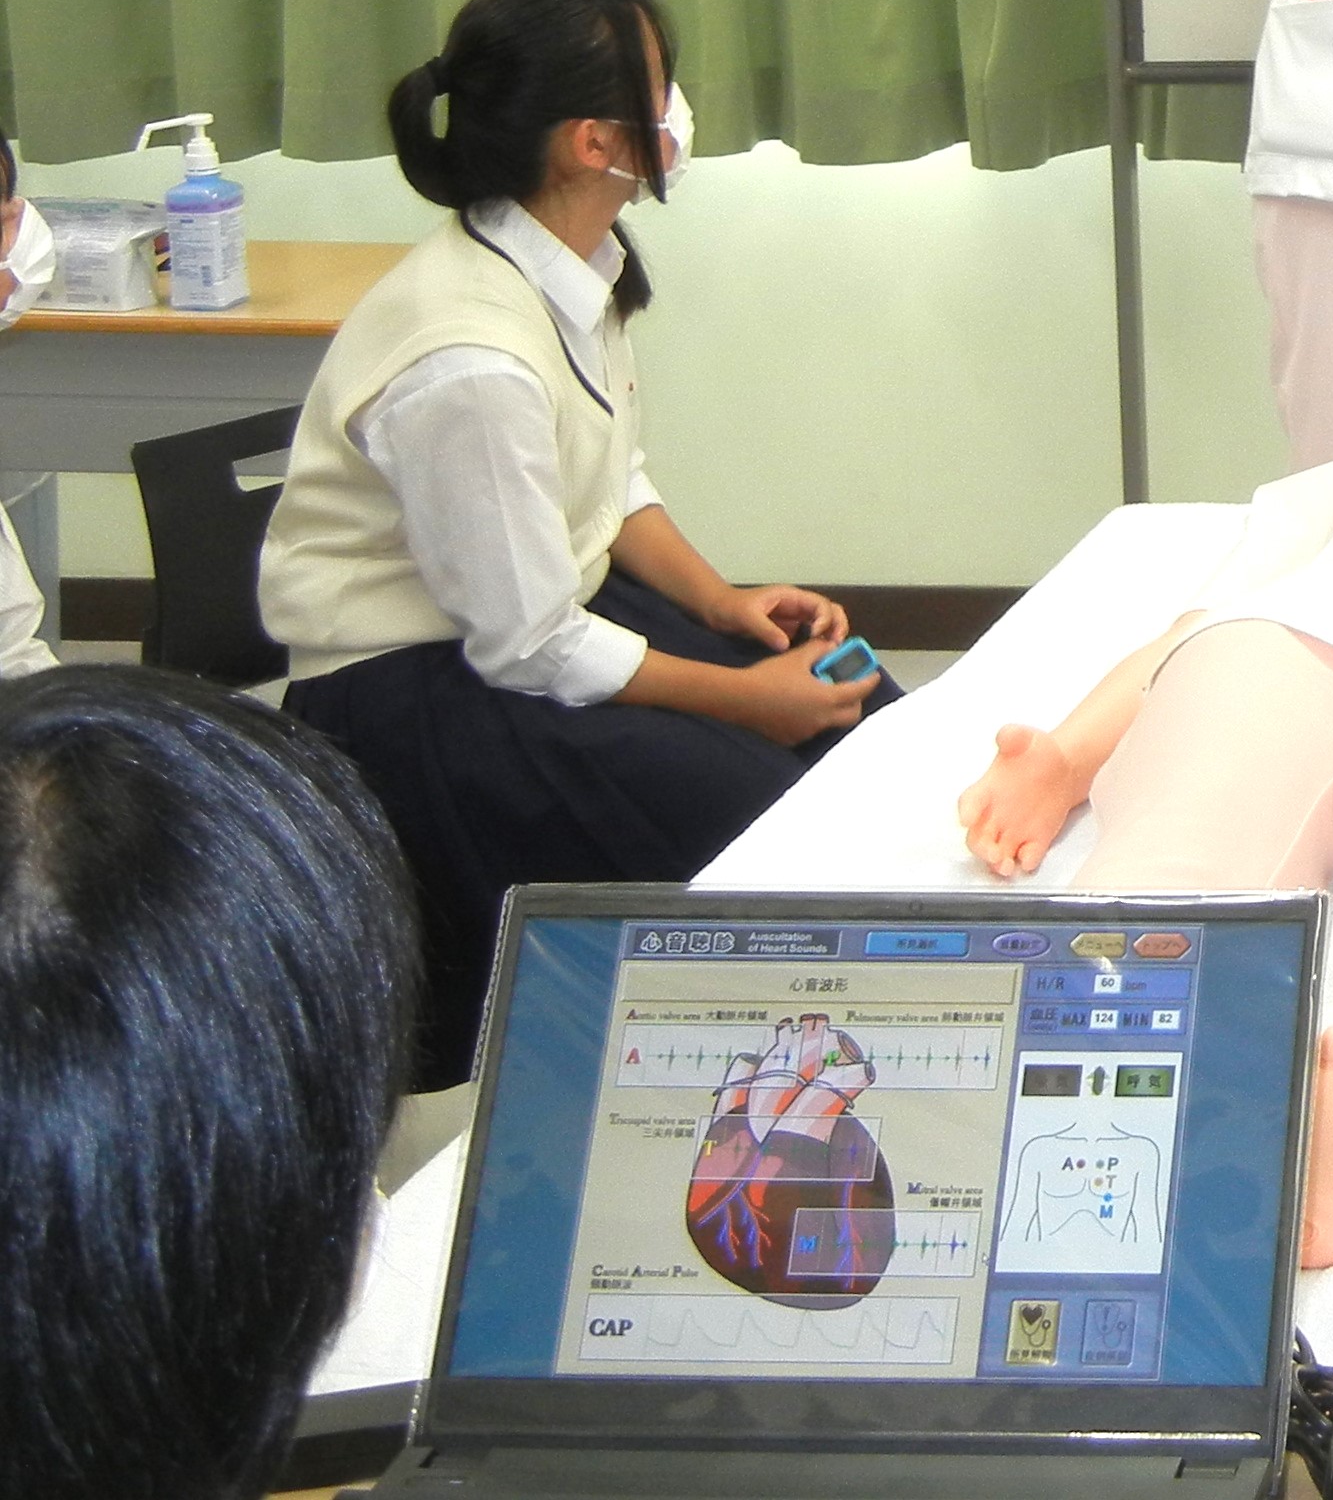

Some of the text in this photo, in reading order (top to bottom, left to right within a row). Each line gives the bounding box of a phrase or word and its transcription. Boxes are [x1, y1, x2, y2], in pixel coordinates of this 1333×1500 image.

[748, 931, 813, 942] Auscultation
[748, 943, 828, 954] of Heart Sounds
[789, 978, 848, 993] 心音波形
[1037, 977, 1066, 990] H/R
[1101, 977, 1115, 988] 60
[1062, 1014, 1086, 1026] MAX
[1095, 1013, 1113, 1023] 124
[1124, 1014, 1148, 1026] MIN
[1158, 1013, 1173, 1024] 82
[625, 1047, 641, 1064] A
[704, 1139, 718, 1156] T
[1061, 1157, 1074, 1171] A
[1107, 1157, 1119, 1171] P
[1105, 1175, 1117, 1189] T
[1100, 1205, 1114, 1219] M
[799, 1235, 818, 1251] M
[589, 1318, 634, 1337] CAP
